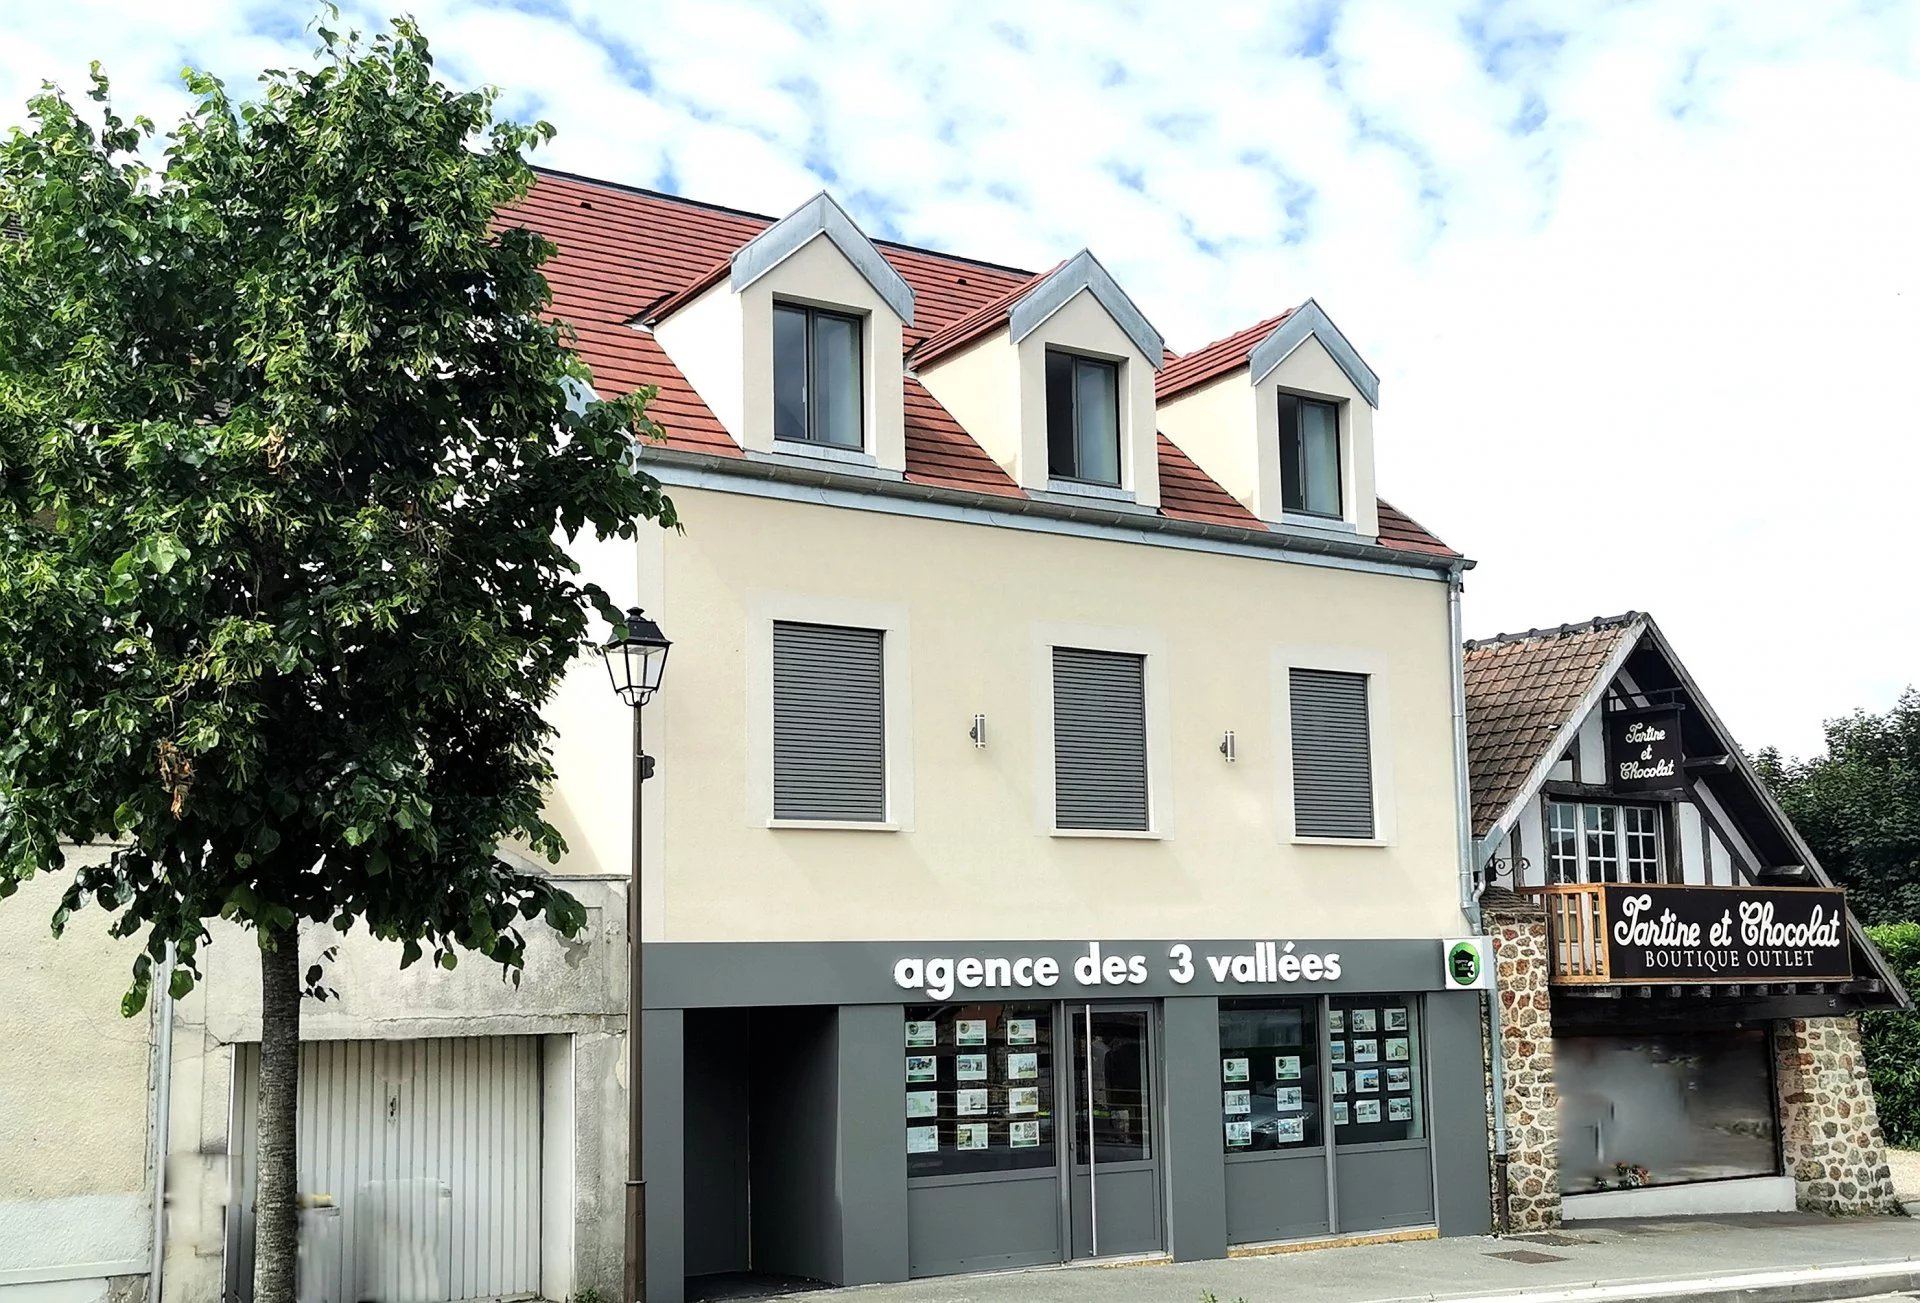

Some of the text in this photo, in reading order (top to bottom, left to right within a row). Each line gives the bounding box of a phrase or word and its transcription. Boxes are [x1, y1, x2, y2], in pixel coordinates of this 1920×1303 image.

[1625, 722, 1666, 743] Tartine
[1640, 744, 1653, 760] et
[1620, 758, 1675, 780] Chocolat
[1613, 893, 1841, 948] Tartine et Chocolat
[893, 940, 1342, 1001] agence des 3 vallées
[1467, 960, 1475, 978] 3
[1645, 949, 1814, 972] BOUTIQUE OUTLET
